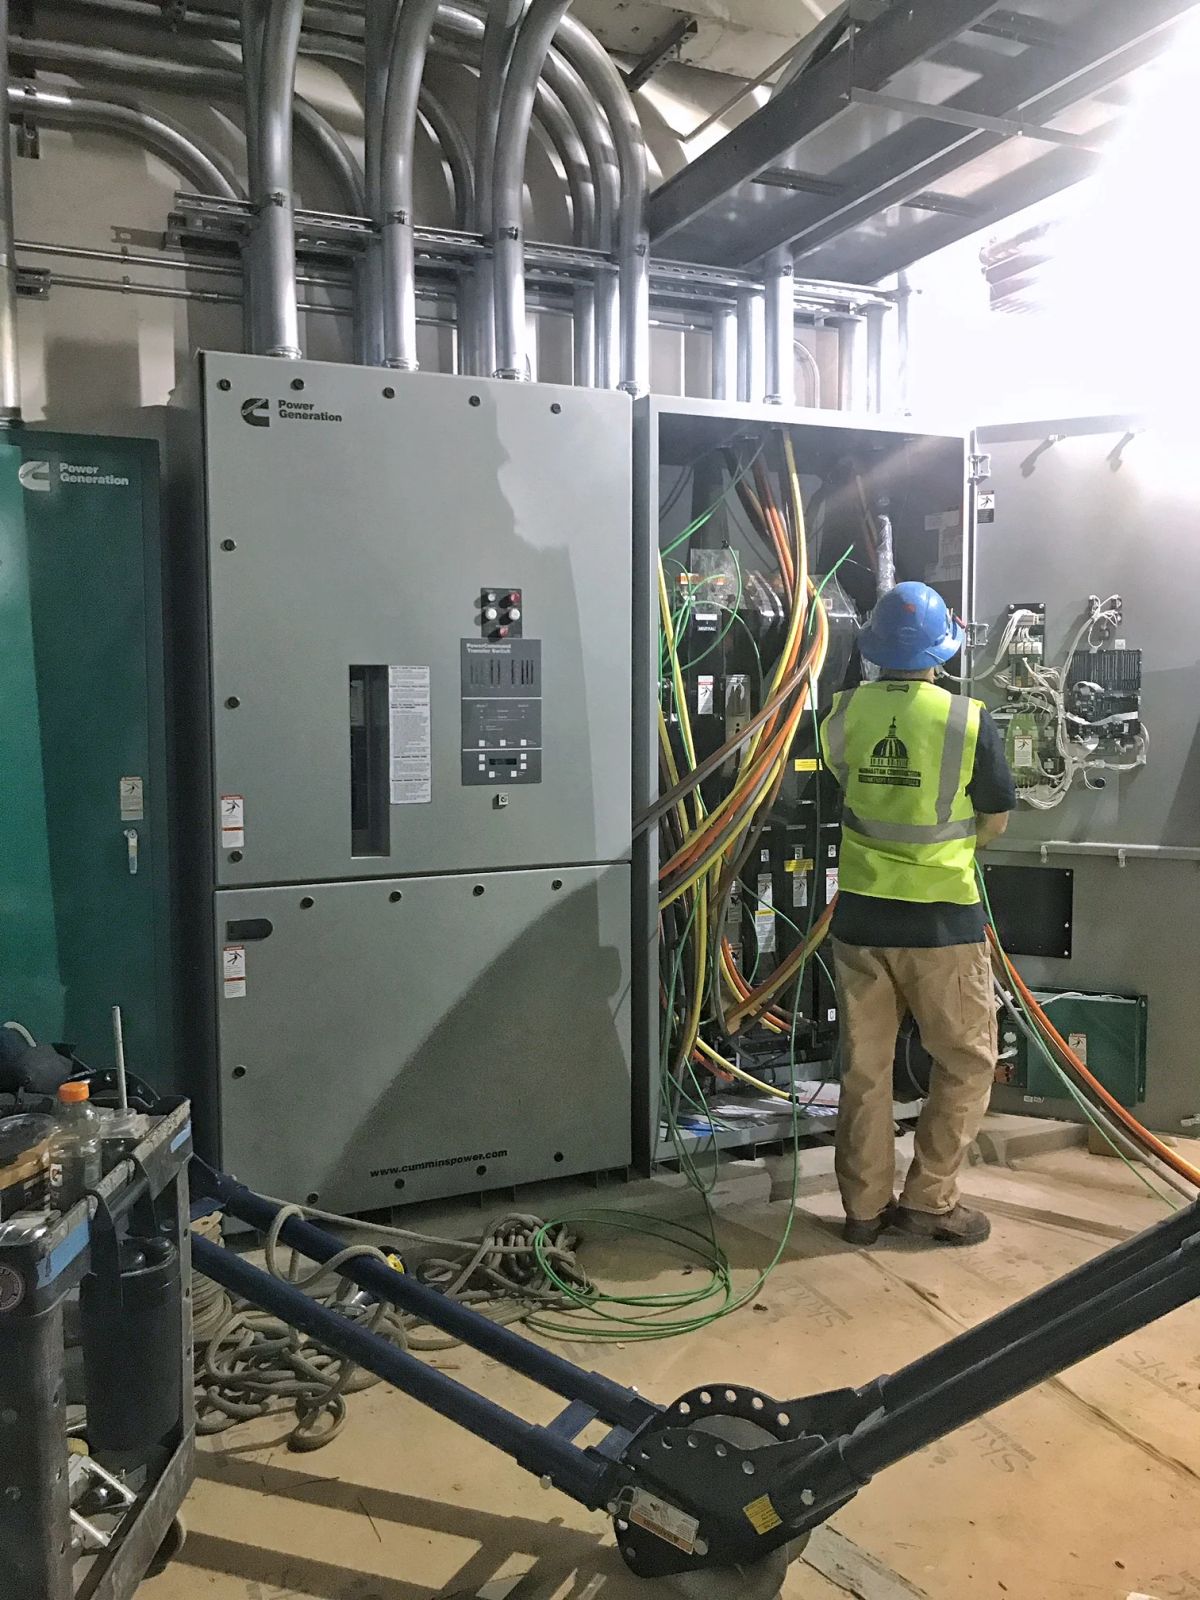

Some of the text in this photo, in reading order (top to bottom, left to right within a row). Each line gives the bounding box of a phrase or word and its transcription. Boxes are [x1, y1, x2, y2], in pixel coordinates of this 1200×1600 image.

[278, 400, 315, 410] Power
[279, 409, 342, 422] Generation
[60, 462, 99, 474] Power
[60, 472, 129, 486] Generation
[369, 1149, 508, 1177] www.cumminspower.com
